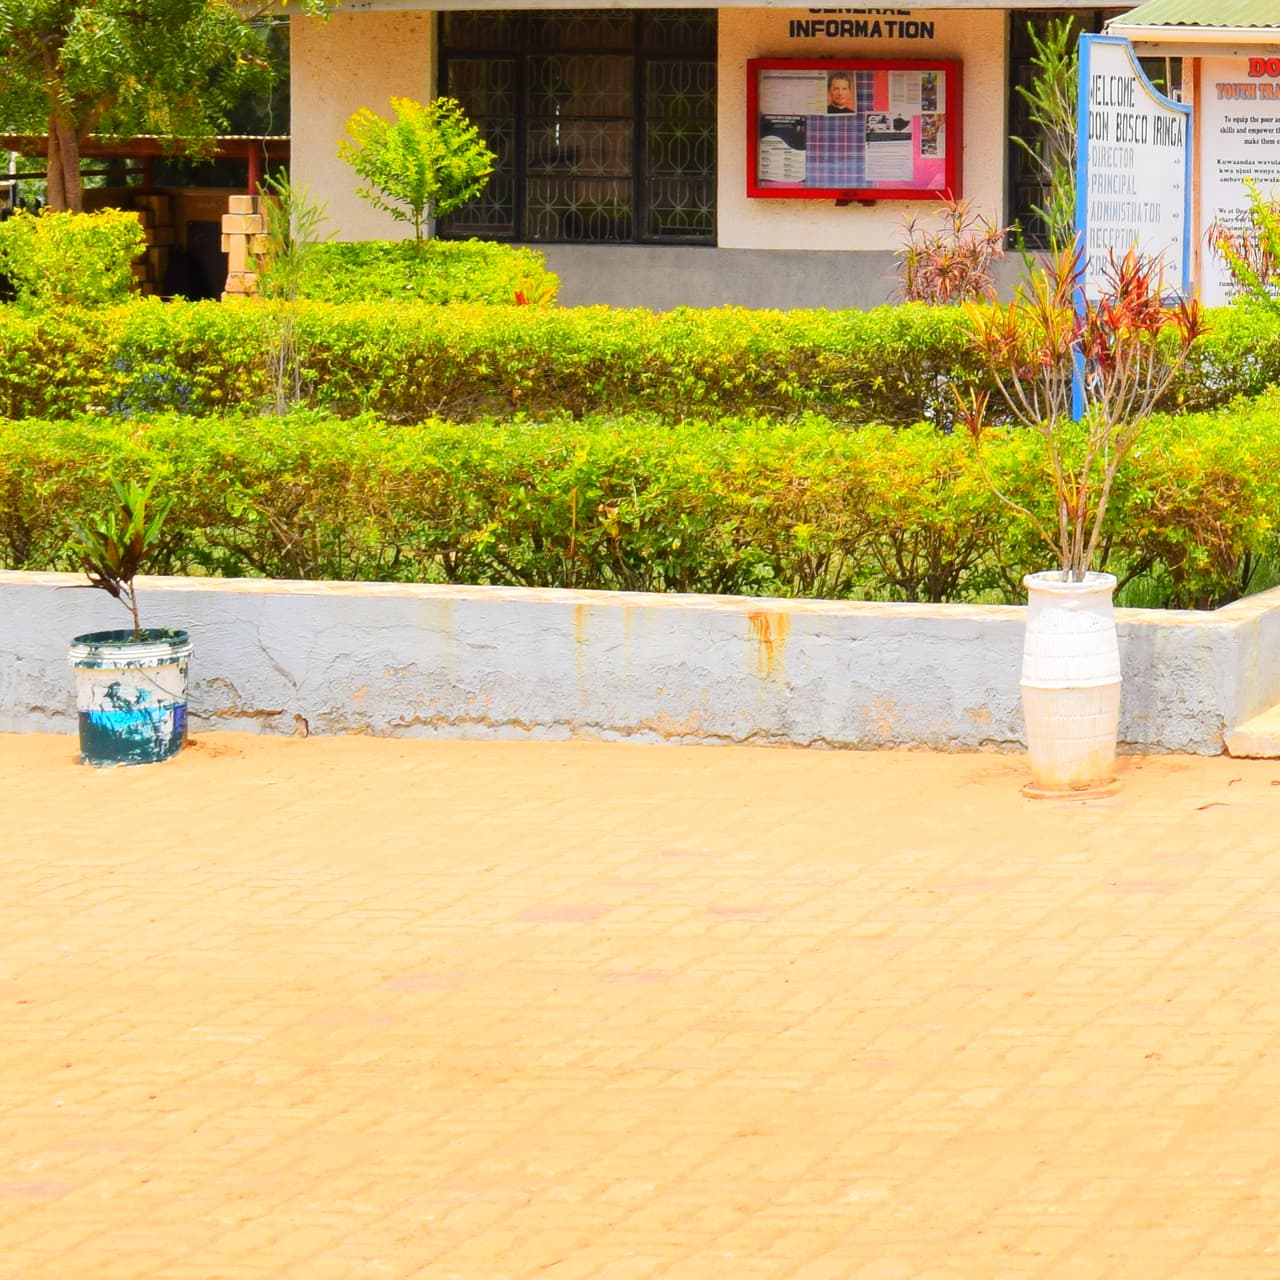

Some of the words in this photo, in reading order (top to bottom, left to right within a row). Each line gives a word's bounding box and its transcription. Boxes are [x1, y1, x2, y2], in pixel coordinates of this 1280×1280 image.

[789, 19, 934, 39] INFORMATION
[1216, 83, 1257, 101] YOUTH
[1088, 111, 1108, 141] DON
[1116, 112, 1148, 144] BOSCO
[1153, 116, 1183, 147] IRINGA
[1220, 126, 1235, 134] skills
[1236, 126, 1247, 134] and
[1248, 128, 1274, 136] empower
[1233, 117, 1248, 125] equip
[1244, 137, 1259, 145] make
[1261, 137, 1275, 145] them
[1092, 146, 1134, 169] DIRECTOR
[1091, 174, 1137, 195] PRINCIPAL
[1090, 201, 1161, 224] ADMINISTRATOR
